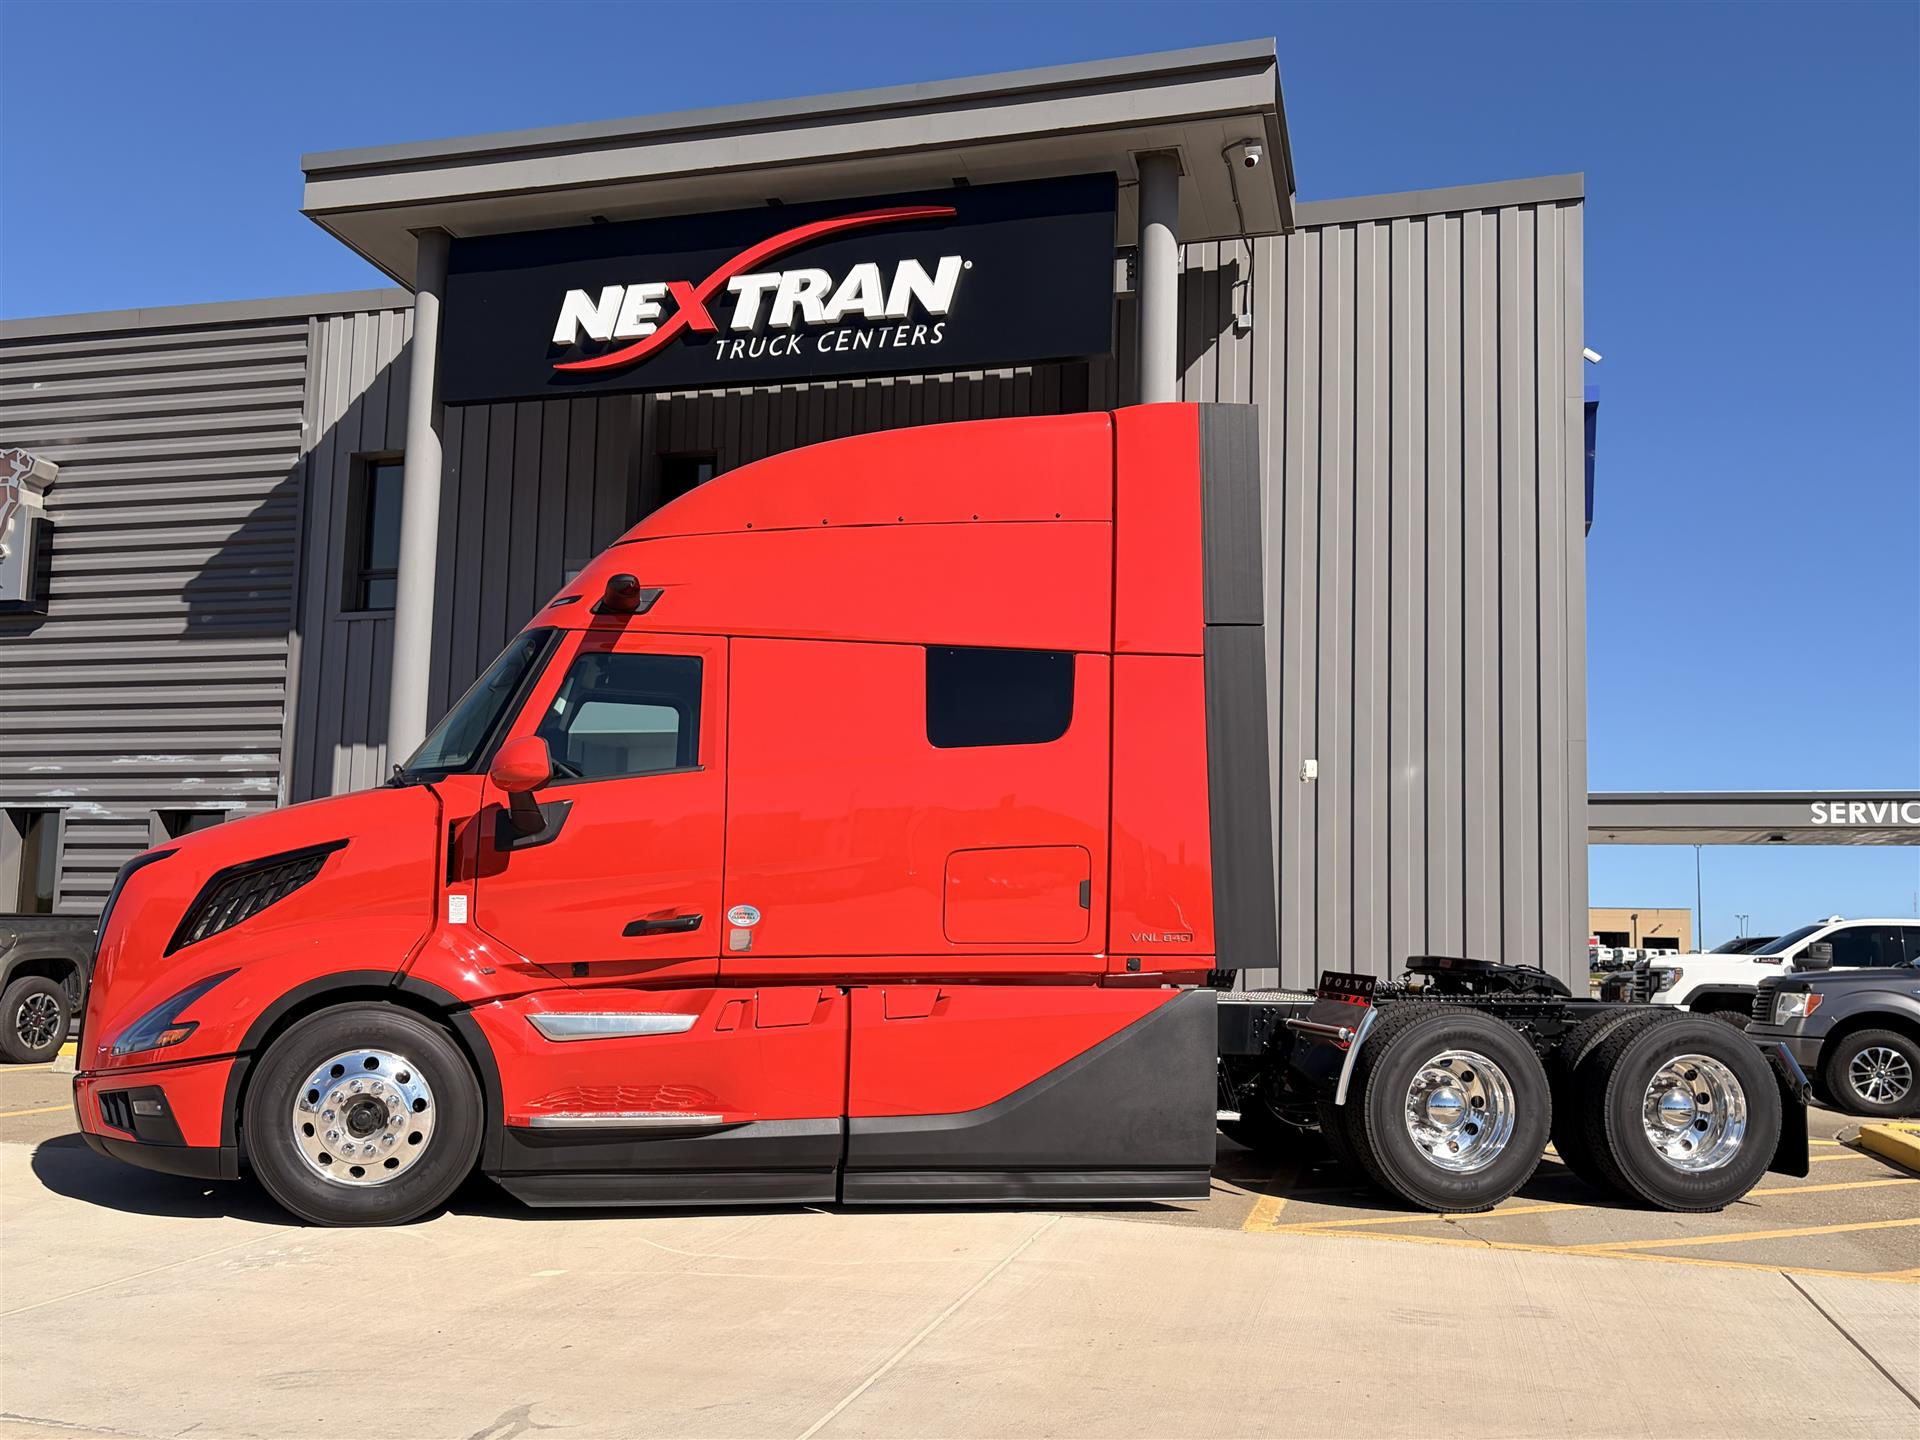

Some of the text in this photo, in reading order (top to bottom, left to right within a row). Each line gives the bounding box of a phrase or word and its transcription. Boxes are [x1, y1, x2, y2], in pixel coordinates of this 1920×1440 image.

[553, 255, 962, 346] NEXTRAN
[716, 322, 946, 361] TRUCK CENTERS
[1811, 800, 1920, 824] SERVIC
[1131, 933, 1163, 942] VNL
[1324, 976, 1373, 991] VOLVO
